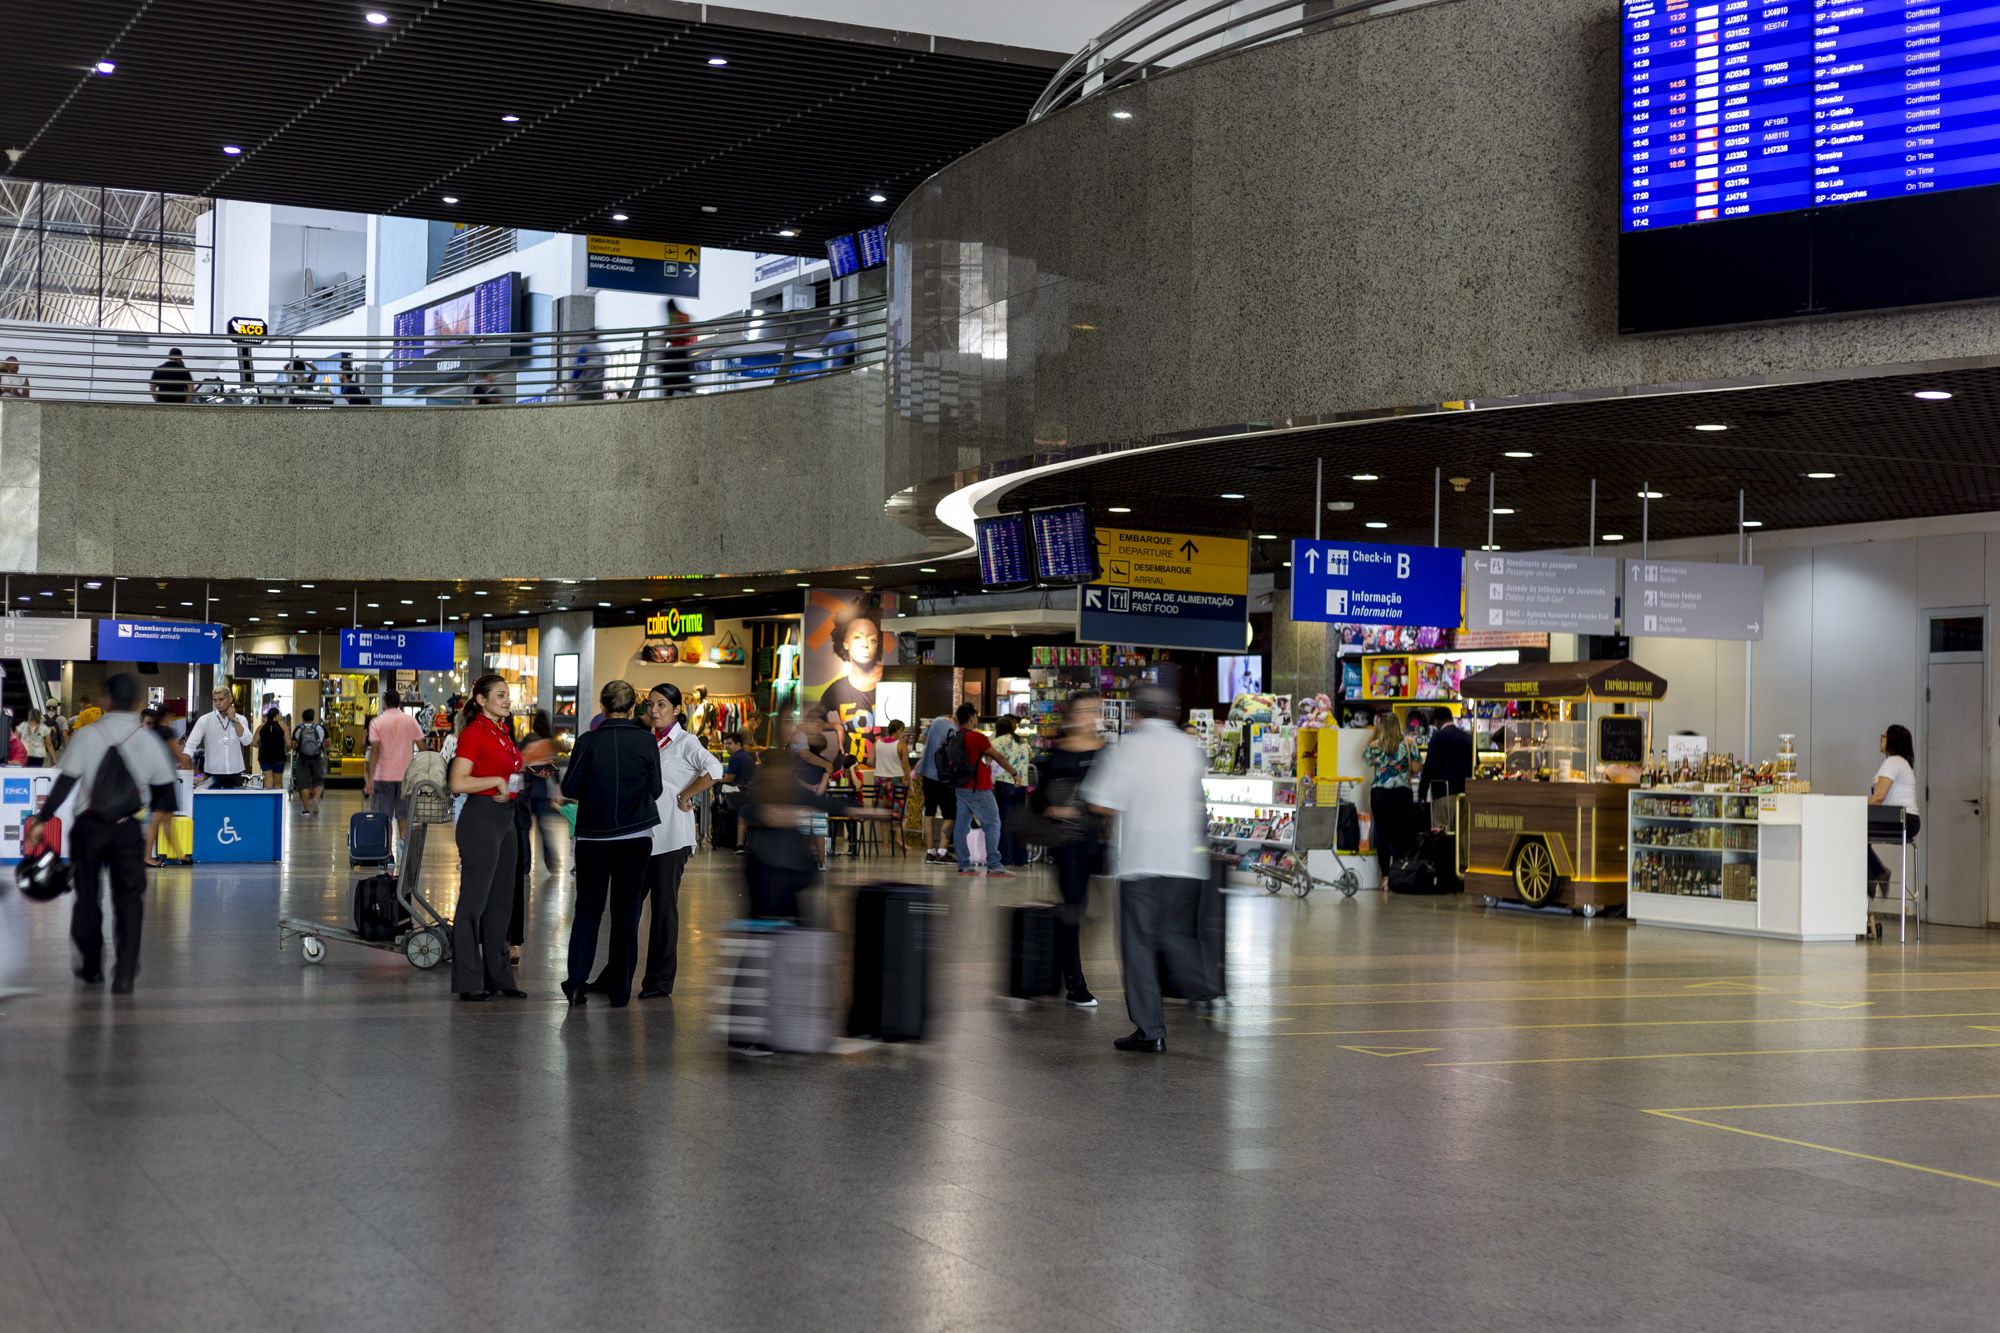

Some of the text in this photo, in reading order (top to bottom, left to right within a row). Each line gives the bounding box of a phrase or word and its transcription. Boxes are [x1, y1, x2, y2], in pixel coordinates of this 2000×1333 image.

[1669, 12, 1686, 21] 13:20
[1763, 7, 1788, 17] LX4910
[1816, 8, 1864, 22] SP Guarulhos
[1906, 7, 1940, 19] Confirmed
[1725, 15, 1748, 25] JJ3574
[1669, 26, 1686, 35] 14:10
[1763, 21, 1789, 31] KE6747
[1906, 21, 1940, 33] Confirmed
[1633, 33, 1650, 42] 13:20
[1906, 36, 1940, 48] Confirmed
[1669, 39, 1686, 48] 13:25
[1633, 46, 1650, 55] 13:35
[1906, 50, 1940, 62] Confirmed
[1763, 62, 1789, 72] TP5055
[1816, 63, 1864, 78] SP Guarulhos
[1906, 64, 1940, 76] Confirmed
[1633, 72, 1650, 82] 14:41
[1763, 76, 1789, 86] TK9454
[1669, 79, 1686, 88] 14:55
[1906, 79, 1940, 91] Confirmed
[1633, 86, 1650, 95] 14:45
[1669, 93, 1686, 102] 14:20
[1816, 94, 1844, 106] Salvador
[1906, 93, 1940, 105] Confirmed
[1669, 106, 1686, 115] 15:19
[1816, 111, 1825, 120] RJ
[1906, 108, 1940, 120] Confirmed
[1633, 112, 1650, 121] 14:54
[1669, 119, 1686, 128] 14:57
[1763, 117, 1789, 127] AF1983
[1816, 120, 1864, 133] SP Guarulhos
[1633, 125, 1650, 135] 15:07
[1906, 122, 1940, 134] Confirmed
[1669, 133, 1686, 142] 15:30
[1763, 131, 1789, 141] AM8110
[1816, 134, 1864, 147] SP Guarulhos
[1633, 139, 1650, 148] 15:45
[1906, 137, 1934, 148] On Time
[1669, 146, 1686, 155] 15:40
[1763, 144, 1788, 155] LH7338
[1816, 151, 1842, 161] Teresina
[1906, 152, 1934, 162] On Time
[1669, 159, 1686, 168] 16:05
[1633, 165, 1650, 174] 16:21
[1918, 166, 1934, 175] Time
[1906, 181, 1934, 191] On Time
[1633, 192, 1650, 201] 17:00
[1816, 190, 1867, 203] SP Congonhas
[1633, 205, 1650, 214] 17:17
[1633, 218, 1650, 227] 17:42
[591, 237, 620, 245] EMBARQUE
[590, 244, 621, 253] DEPARTURE
[590, 255, 634, 264] BANCO-CÂMBIO
[590, 262, 635, 272] BANK-EXCHANGE
[1119, 533, 1173, 546] EMBARQUE
[1118, 546, 1174, 559] DEPARTURE
[1134, 563, 1192, 575] DESEMBARQUE
[1353, 550, 1410, 579] Check-in B
[1506, 558, 1540, 568] Atendimento
[1549, 562, 1578, 571] passageiro
[1506, 568, 1535, 578] Passenger
[1134, 576, 1166, 586] ARRIVAL
[1505, 584, 1528, 592] Juizado
[1538, 585, 1561, 594] Infância
[1576, 588, 1606, 596] Juventude
[1659, 590, 1702, 600] Receita Federal
[1132, 591, 1234, 607] PRAÇA DE ALIMENTAÇÃO
[1352, 591, 1402, 605] Informação
[1132, 603, 1179, 614] FAST FOOD
[1351, 605, 1403, 618] Information
[647, 612, 668, 635] color
[134, 624, 171, 634] Desembarque
[134, 632, 158, 640] Domestic
[374, 634, 406, 648] Check-in B
